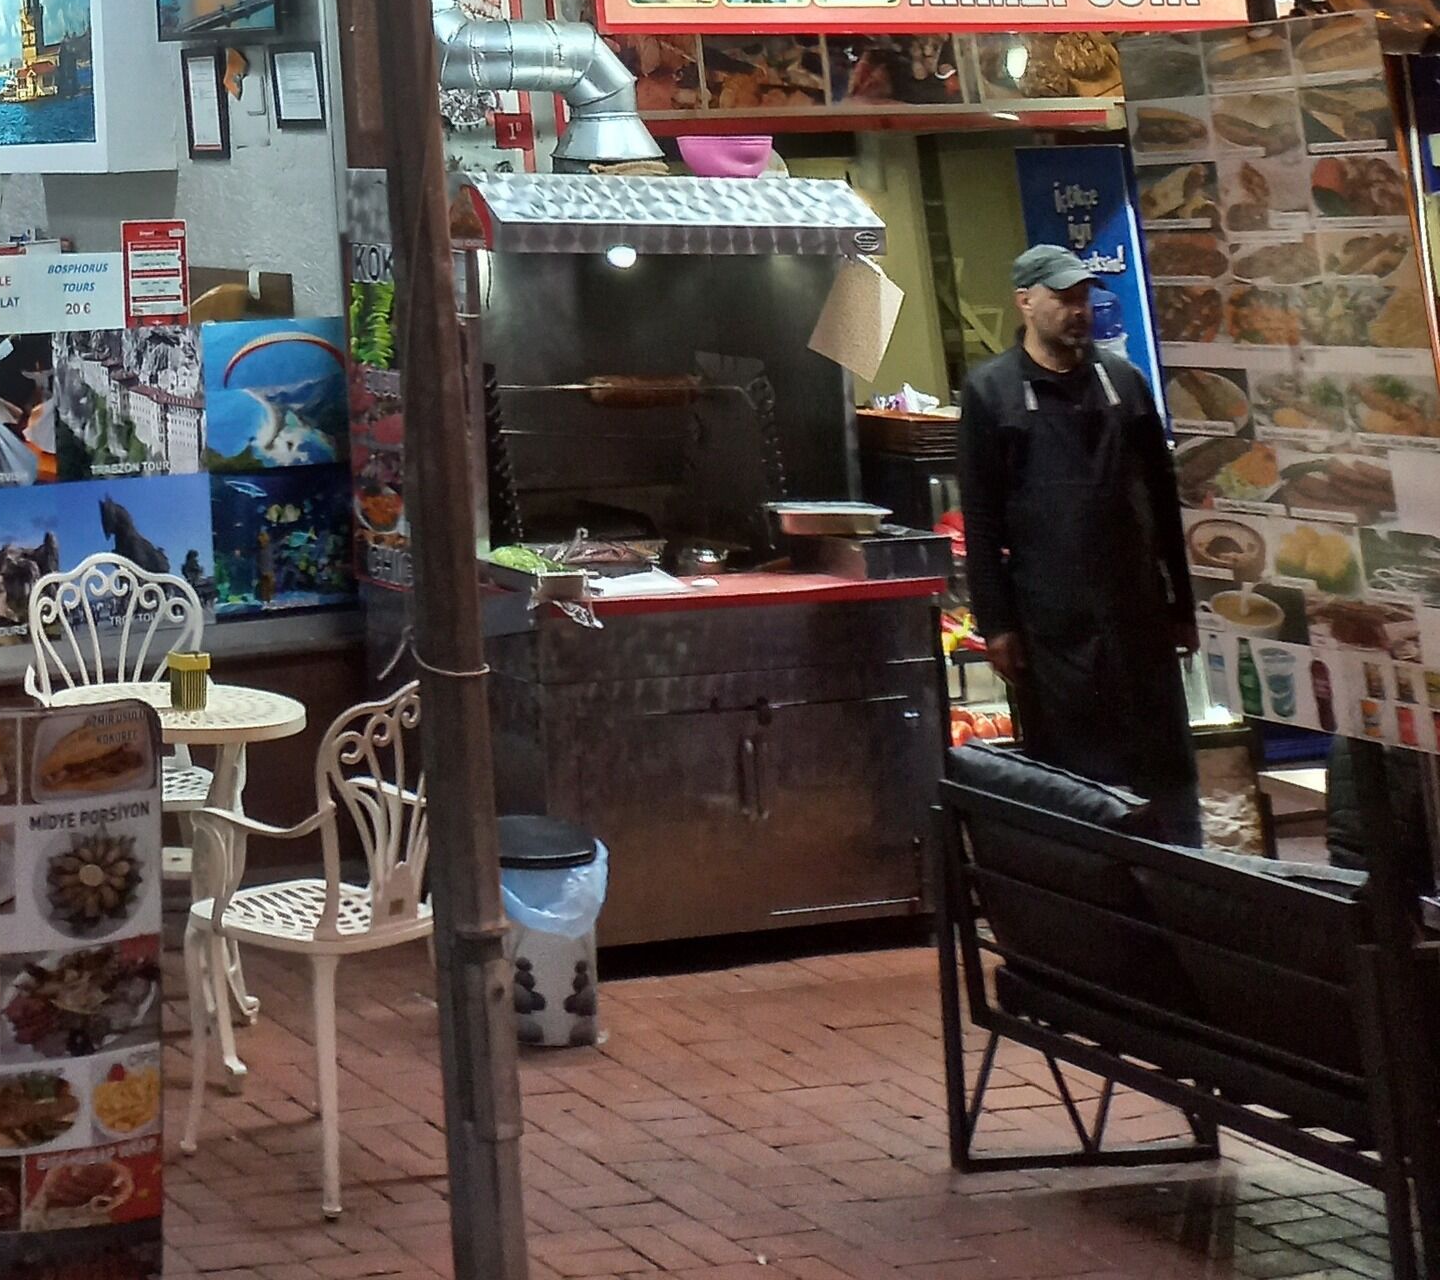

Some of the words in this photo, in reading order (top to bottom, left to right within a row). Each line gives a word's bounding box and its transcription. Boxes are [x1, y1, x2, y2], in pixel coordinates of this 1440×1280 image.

[47, 262, 109, 275] BOSPHORUS
[62, 282, 96, 294] TOURS
[65, 302, 80, 316] 20
